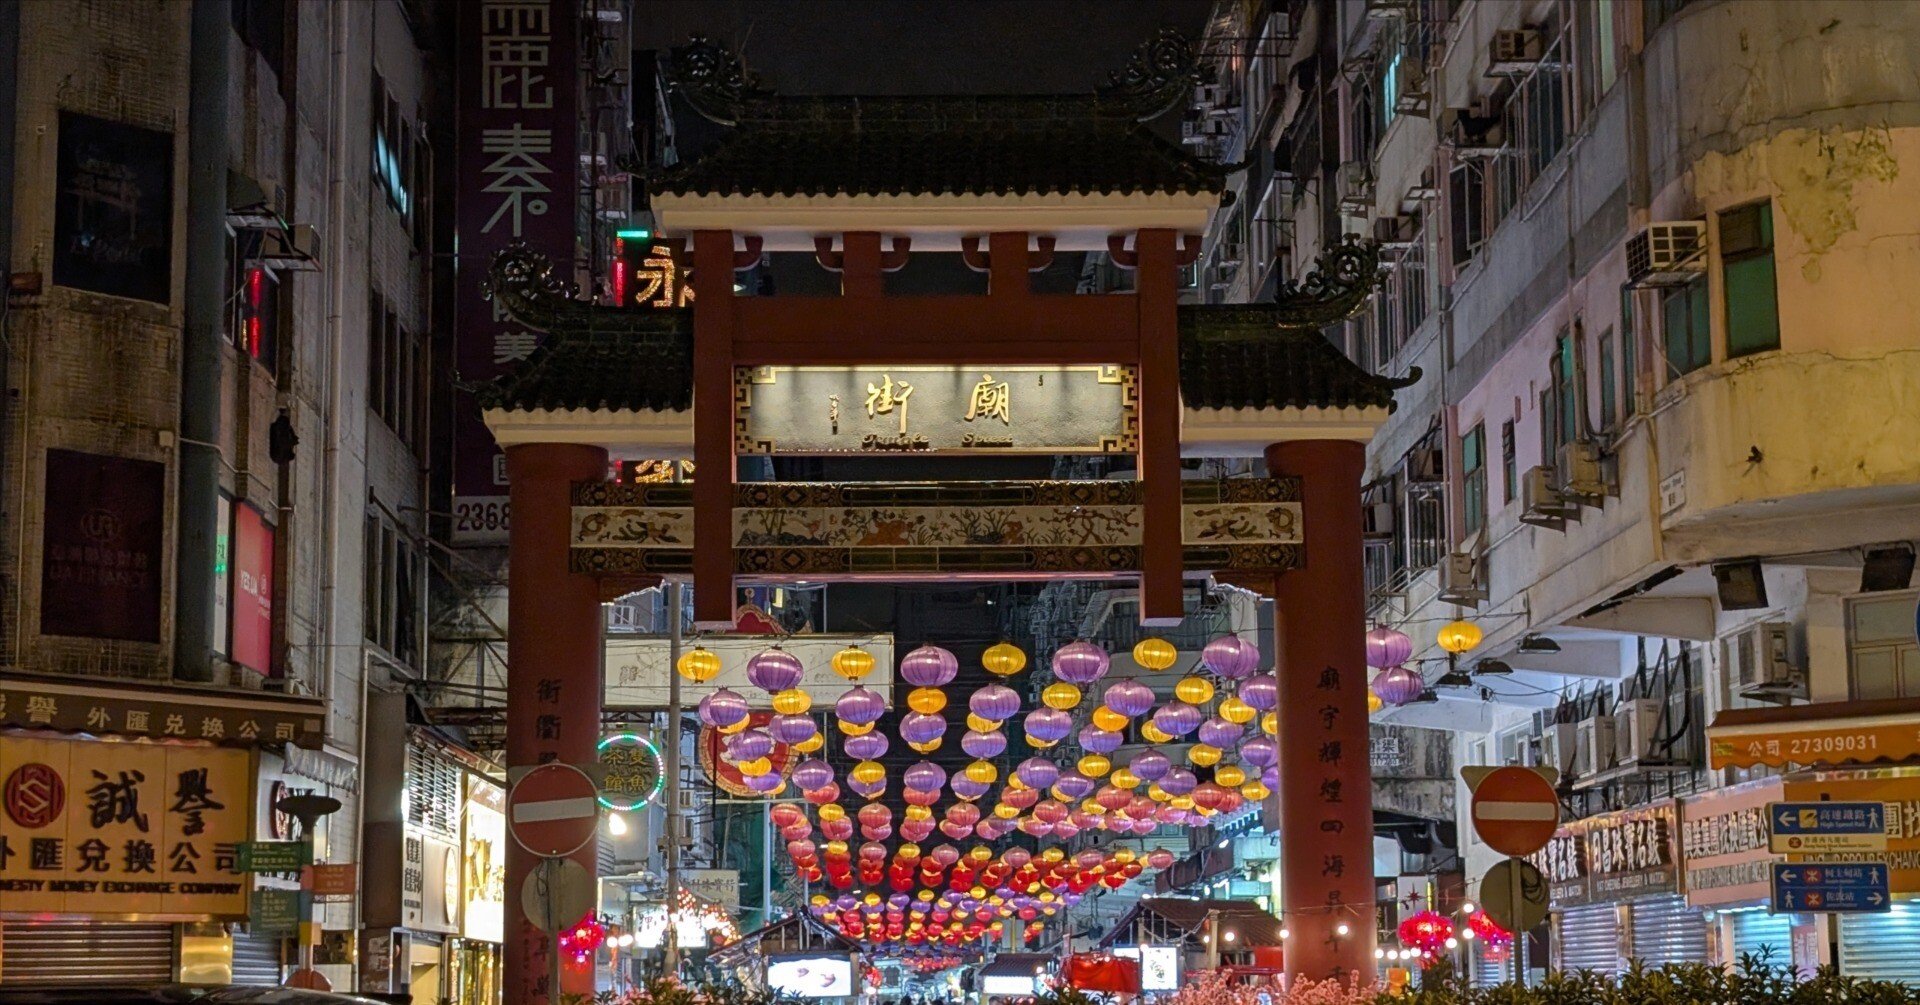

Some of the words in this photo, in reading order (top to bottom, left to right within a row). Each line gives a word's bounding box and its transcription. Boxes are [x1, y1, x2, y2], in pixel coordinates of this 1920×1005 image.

[865, 374, 1010, 435] 廟街
[962, 432, 1013, 447] Street
[1749, 739, 1780, 757] 公司
[1791, 735, 1878, 754] 27309031
[85, 767, 225, 836] 誠譽
[1820, 809, 1865, 820] 高速鐵路
[50, 880, 99, 892] MONEY
[103, 881, 175, 893] EXCHANGE
[179, 882, 242, 895] COMPANY
